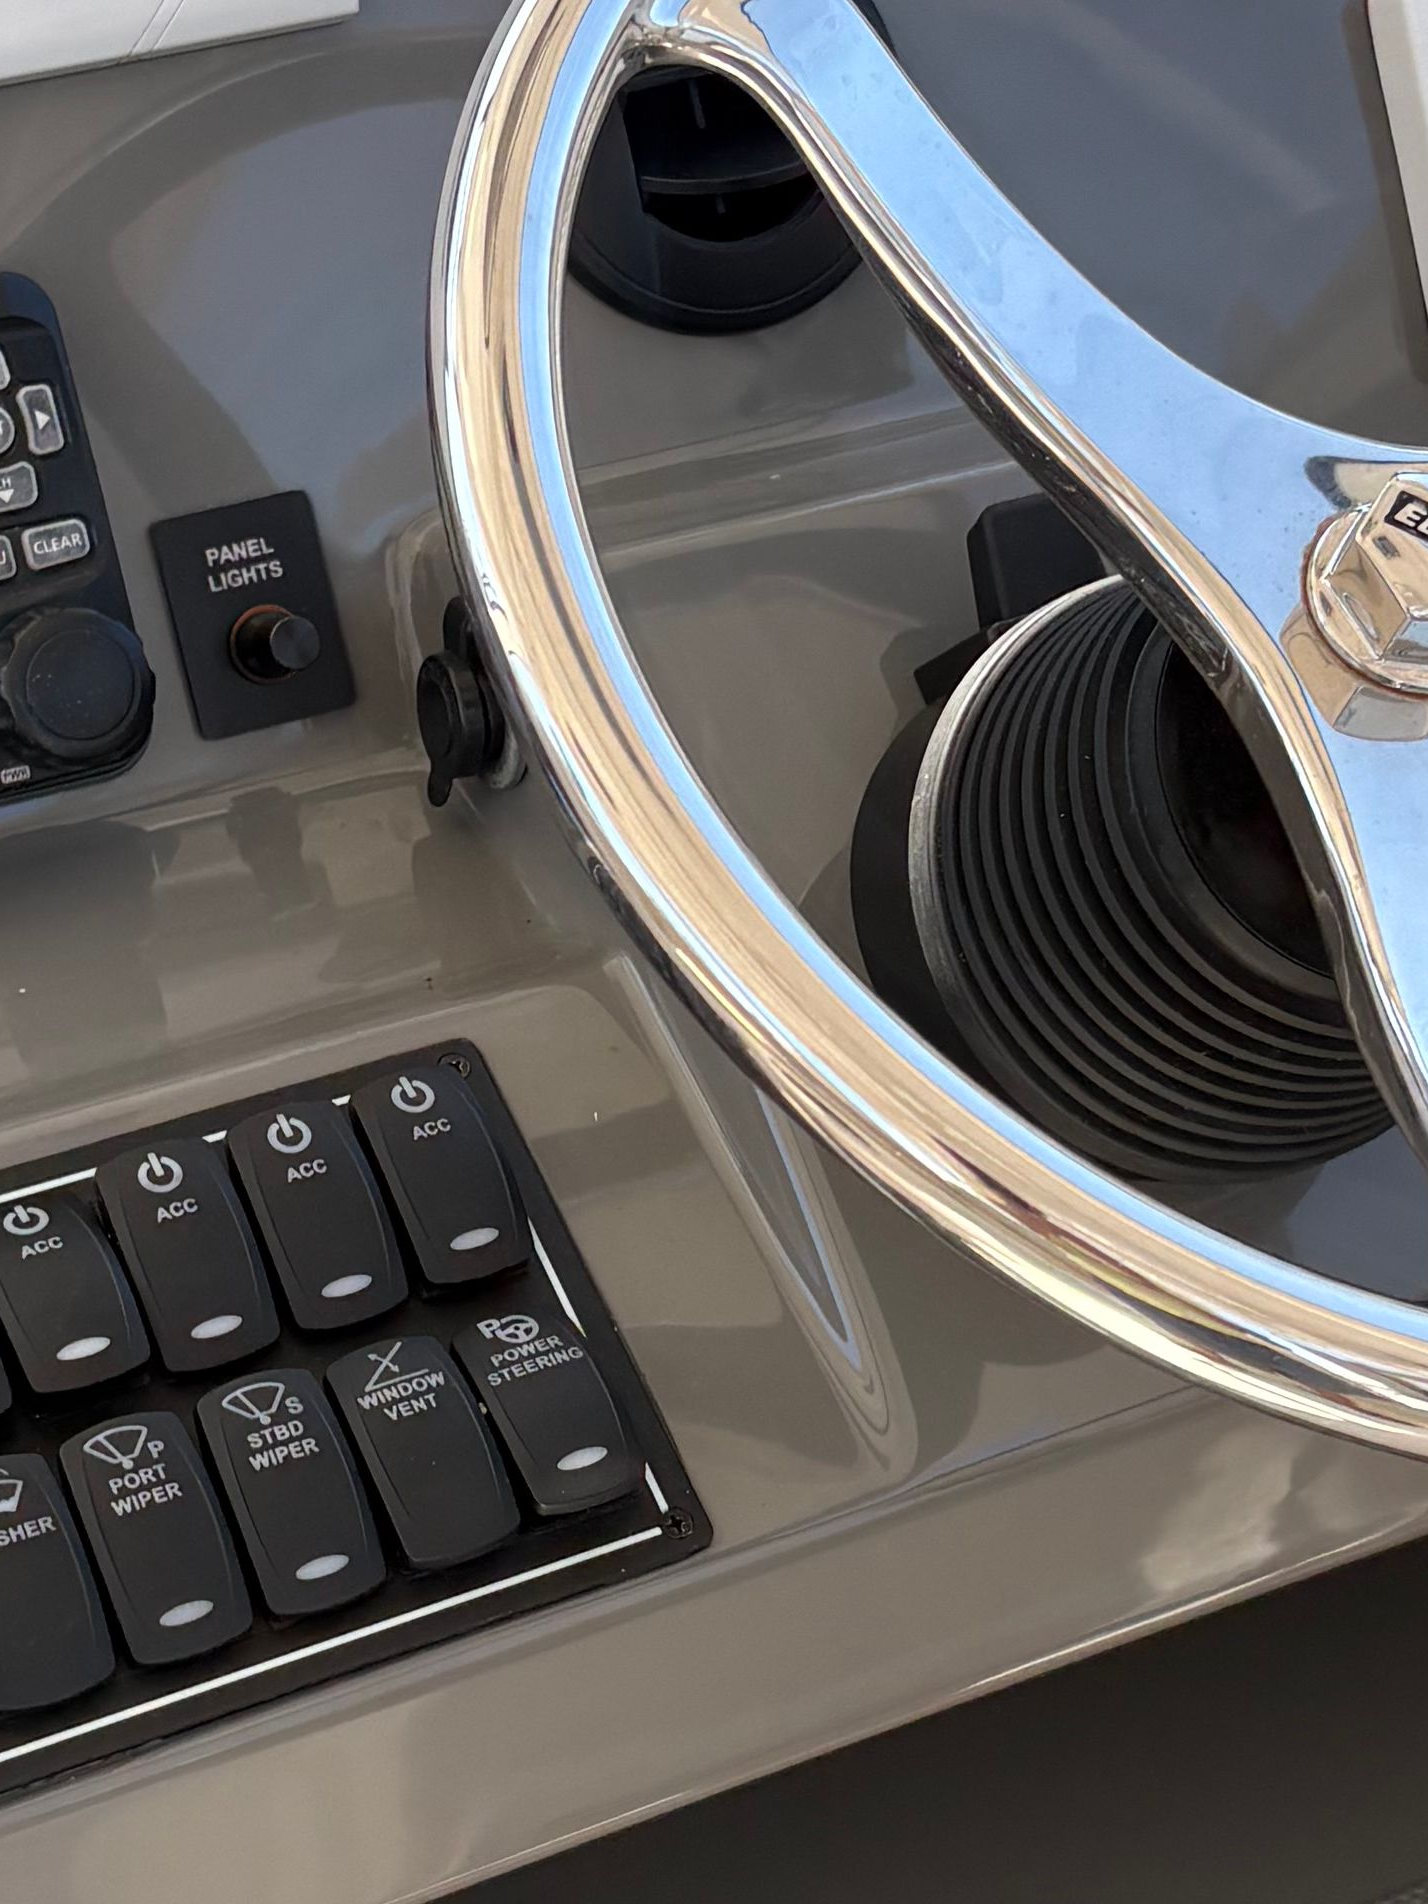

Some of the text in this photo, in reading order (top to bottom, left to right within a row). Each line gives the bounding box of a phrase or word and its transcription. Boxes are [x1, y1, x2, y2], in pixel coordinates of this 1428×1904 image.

[32, 532, 83, 556] CLEAR
[204, 535, 275, 568] PANEL
[208, 560, 285, 594] LIGHTS
[412, 1118, 452, 1141] ACC
[286, 1159, 327, 1183] ACC
[156, 1198, 199, 1223] ACC
[21, 1235, 64, 1260] ACC
[489, 1335, 564, 1368] POWER
[487, 1346, 584, 1388] STEERING
[284, 1397, 304, 1414] S
[356, 1371, 445, 1410] WINDOW
[383, 1392, 439, 1422] VENT
[146, 1439, 165, 1460] P
[246, 1420, 304, 1449] STBD
[248, 1437, 320, 1472] WIPER
[108, 1463, 167, 1495] PORT
[110, 1482, 183, 1517] WIPER
